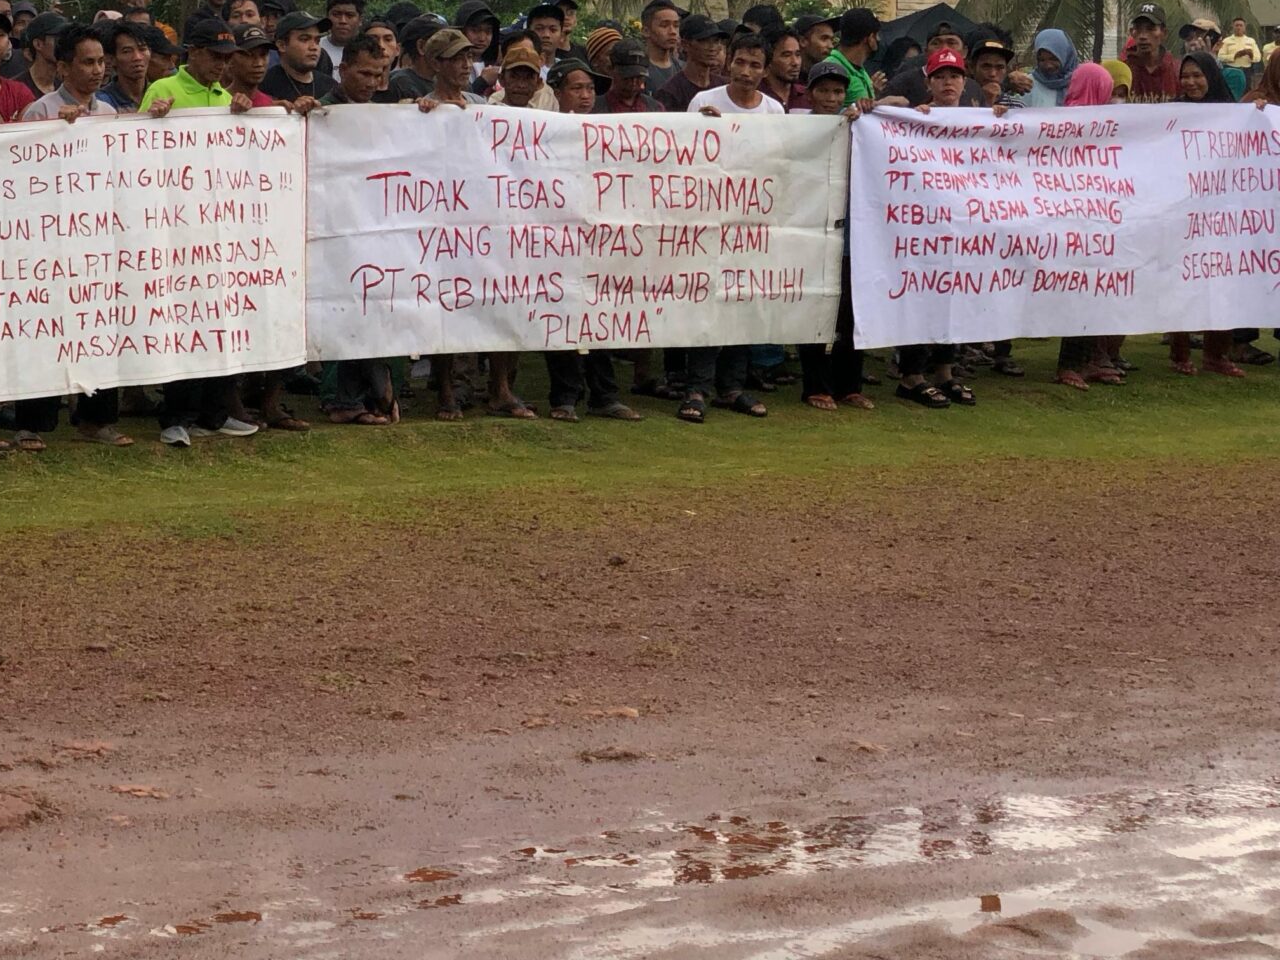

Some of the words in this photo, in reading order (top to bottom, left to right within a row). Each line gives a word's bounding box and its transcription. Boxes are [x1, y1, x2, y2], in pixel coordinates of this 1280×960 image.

[103, 133, 128, 156] PT
[136, 129, 196, 149] REBIN
[881, 120, 985, 139] MASYARAKAT
[990, 124, 1023, 137] DESA
[1039, 122, 1084, 139] PELEPAK
[1090, 120, 1118, 137] PUTE
[888, 146, 935, 164] DUSUN
[970, 146, 1018, 164] KALAK
[1027, 144, 1122, 168] MENUNTUT
[30, 165, 193, 195] BERTANGUNG
[488, 175, 565, 210] TEGAS
[649, 173, 773, 215] REBINMAS
[923, 172, 988, 192] REBINMAS
[993, 171, 1020, 189] JAYA
[1033, 172, 1135, 198] REALISASIKAN
[1189, 170, 1226, 194] MANA
[1232, 167, 1280, 191] KEBU
[144, 205, 188, 228] HAK
[886, 204, 951, 225] KEBUN
[966, 198, 1028, 223] PLASMA
[1033, 196, 1121, 224] SEKARANG
[1184, 212, 1237, 239] JANGAN
[1240, 209, 1274, 235] ADU
[417, 224, 491, 264] YANG
[510, 224, 643, 258] MERAMPAS
[658, 224, 708, 256] HAK
[720, 222, 769, 254] KAMI
[895, 233, 996, 258] HENTIKAN
[1000, 234, 1057, 260] JANJI
[1066, 232, 1114, 256] PALSU
[1183, 252, 1233, 281] SEGERA
[69, 281, 128, 304] UNTUK
[350, 263, 405, 315] PT
[411, 271, 564, 314] REBINMAS
[587, 272, 633, 307] JAYA
[643, 272, 710, 303] WAJIB
[722, 268, 803, 303] PENUHI
[889, 270, 983, 299] JANGAN
[989, 267, 1025, 292] ADU
[1032, 269, 1088, 293] DOMBA
[1095, 270, 1134, 296] KAMI
[0, 316, 64, 340] AKAN
[75, 303, 137, 330] TAHU
[148, 290, 257, 326] MARAHNYA
